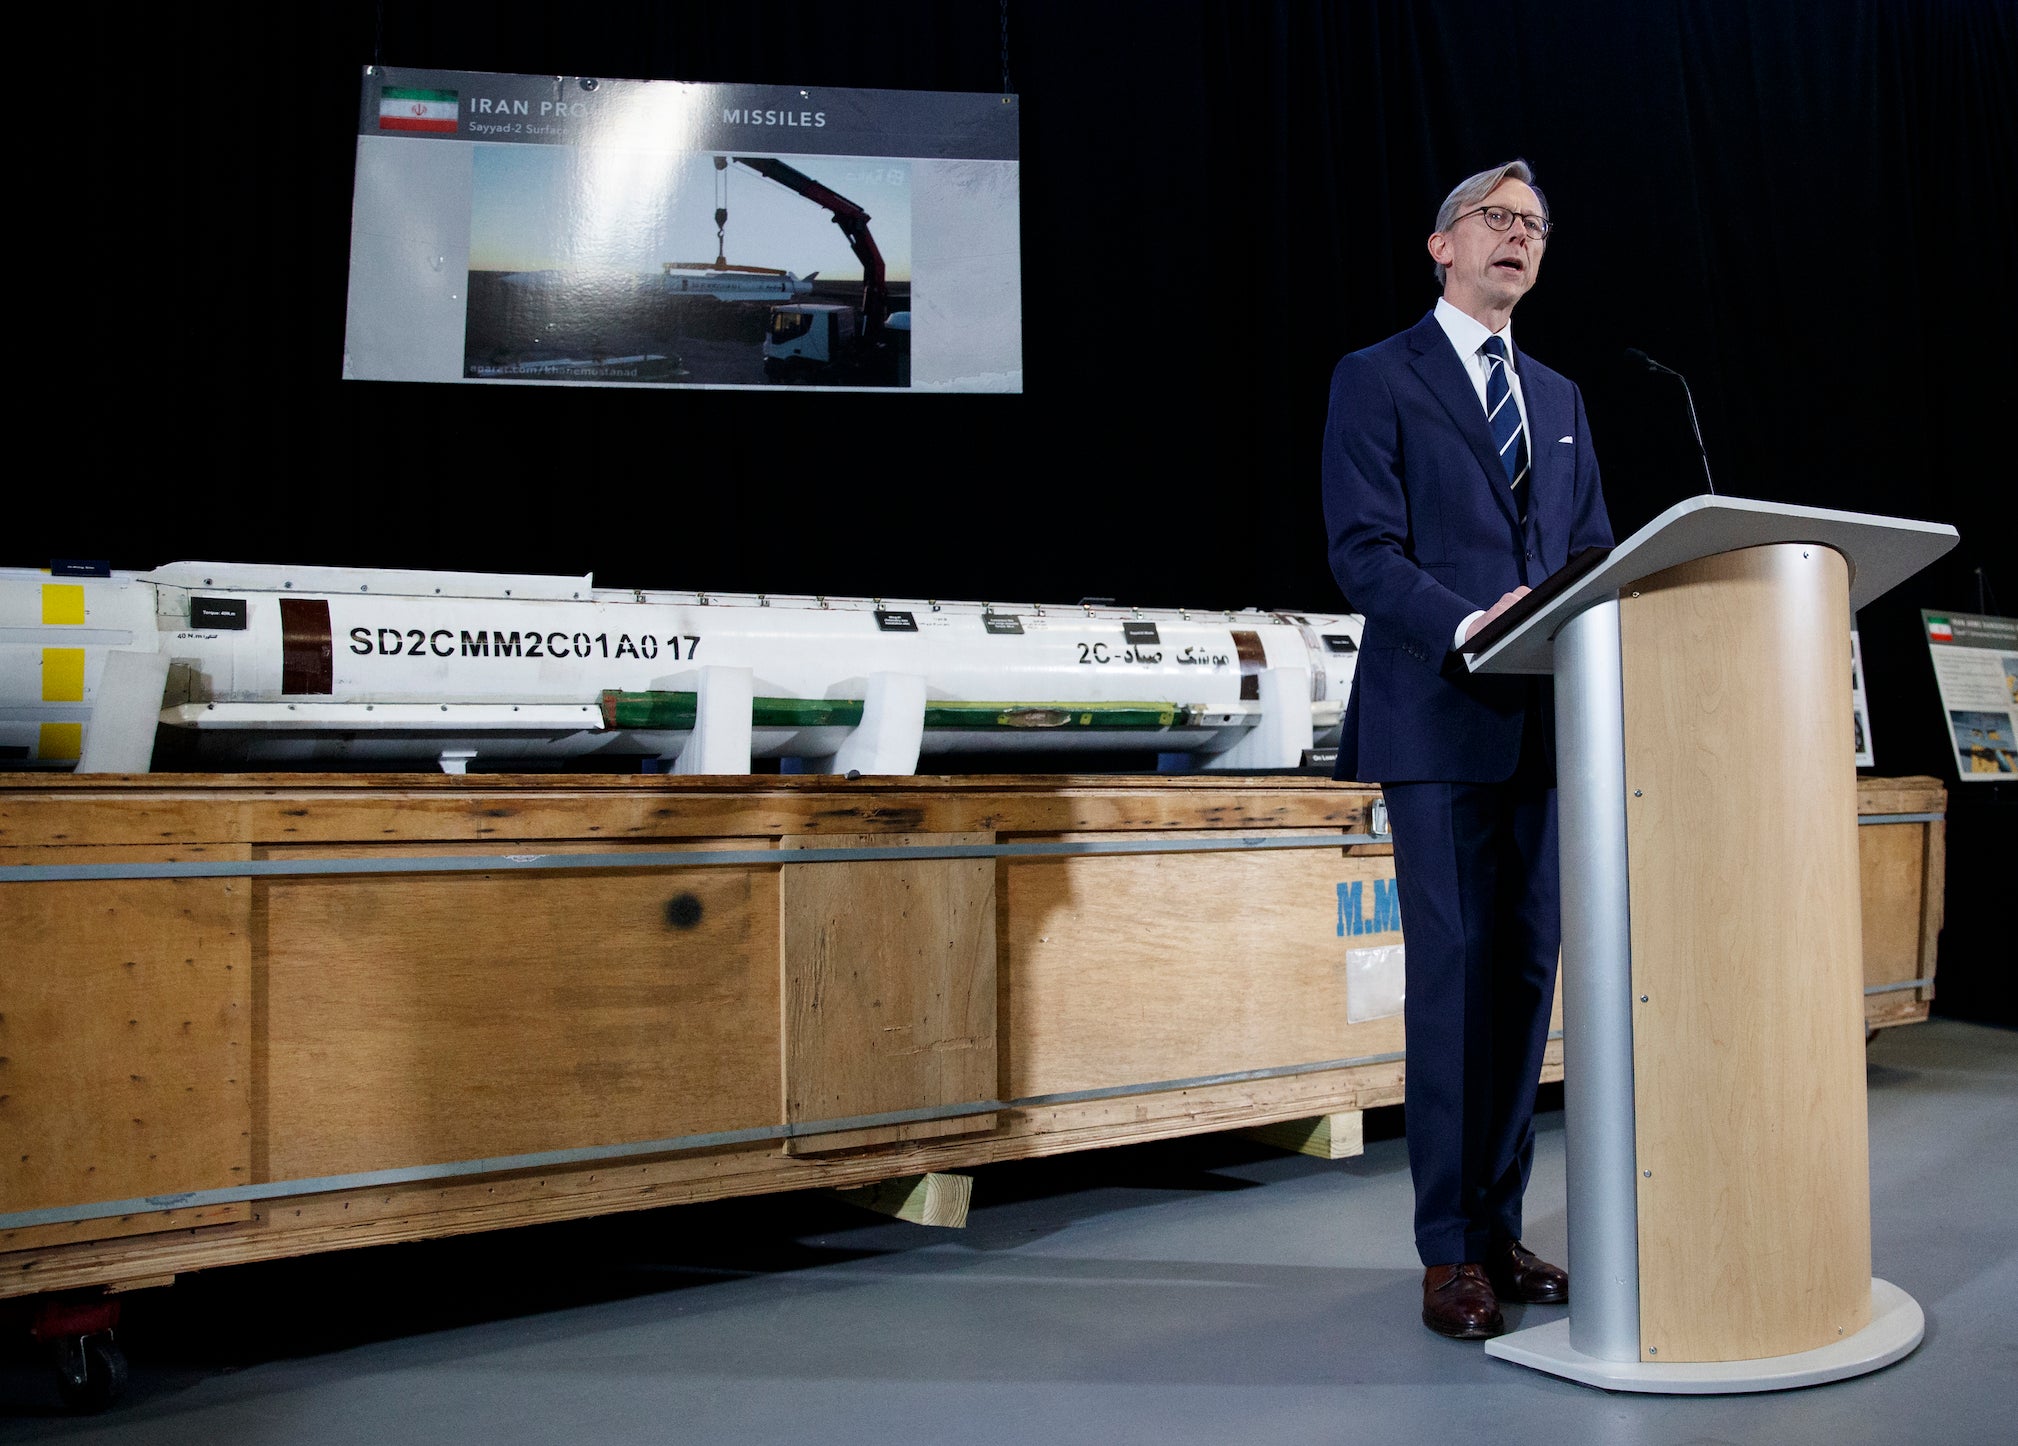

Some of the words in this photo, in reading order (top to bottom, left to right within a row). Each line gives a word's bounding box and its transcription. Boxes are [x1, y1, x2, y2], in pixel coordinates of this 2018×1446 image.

[471, 98, 529, 116] IRAN
[723, 109, 827, 127] MISSILES
[469, 122, 522, 135] Sayyad-2
